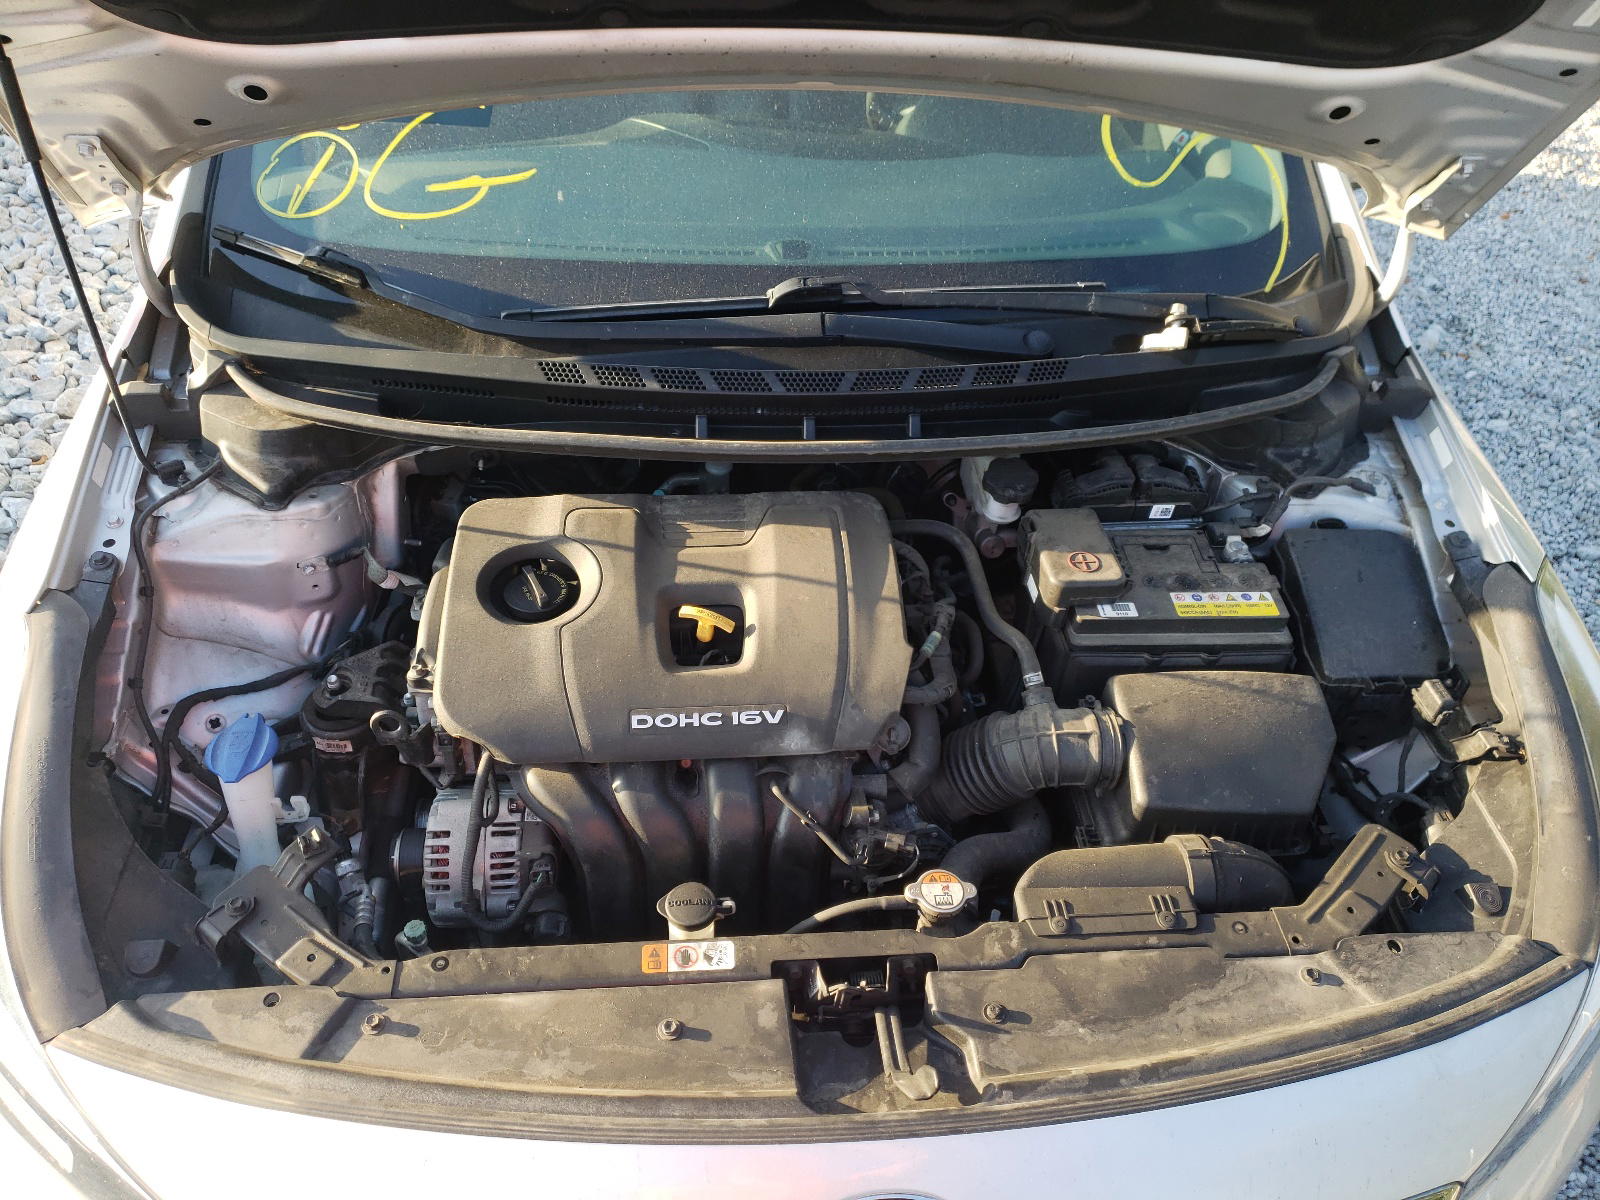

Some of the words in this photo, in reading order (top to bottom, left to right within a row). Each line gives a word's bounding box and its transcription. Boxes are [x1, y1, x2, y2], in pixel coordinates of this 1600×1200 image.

[631, 712, 723, 729] DOHC
[731, 709, 785, 725] 16V
[668, 898, 714, 908] COOLANT
